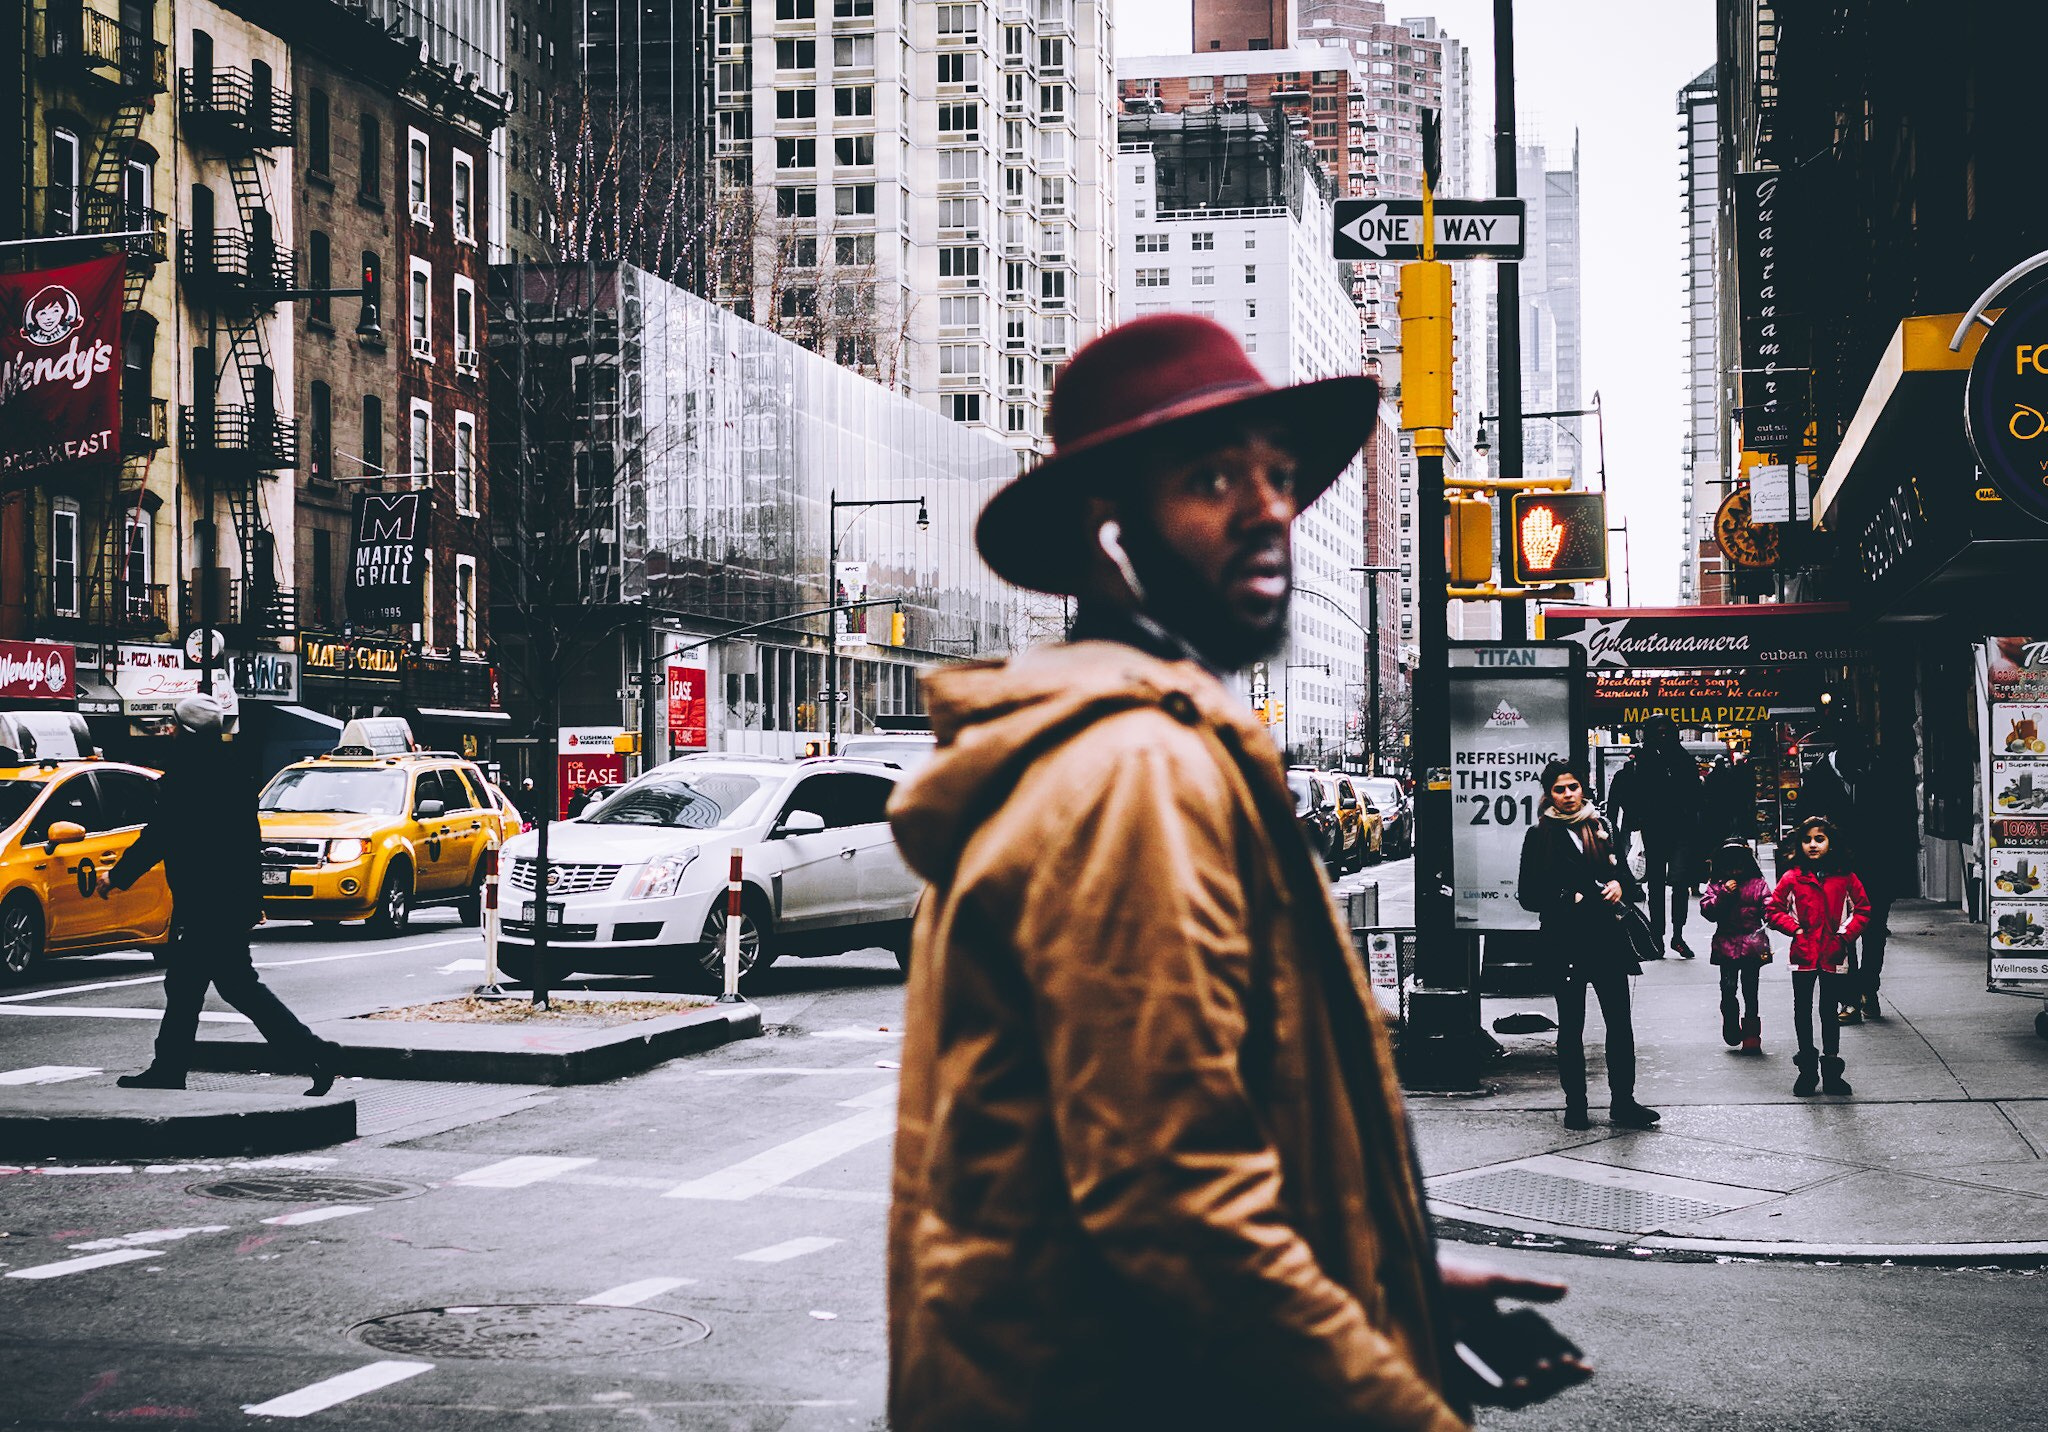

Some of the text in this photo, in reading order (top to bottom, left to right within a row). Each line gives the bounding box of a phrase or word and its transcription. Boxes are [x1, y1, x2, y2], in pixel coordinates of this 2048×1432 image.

[1358, 218, 1497, 242] ONE WAY
[1754, 177, 1781, 414] Guantanamera
[0, 335, 113, 405] Wendy's
[3, 429, 112, 474] BREAKFAST
[360, 494, 418, 542] M
[356, 544, 413, 566] MATTS
[355, 563, 411, 587] GRILL
[380, 606, 401, 618] 1995
[1589, 627, 1752, 661] Guantanamera
[131, 652, 152, 668] PIZZA
[157, 654, 180, 669] PASTA
[306, 642, 355, 670] MAT
[356, 646, 398, 672] GRILL
[1474, 649, 1536, 666] TITAN
[1760, 649, 1863, 661] cuban cuisin
[0, 650, 45, 691] Wendy's
[670, 680, 692, 701] LEASE
[1253, 661, 1266, 710] PARK
[1596, 677, 1653, 687] Breakfast
[1994, 683, 2021, 691] Fresh
[1593, 688, 1781, 698] Sandwich Pasta Cakes We Cater
[130, 702, 158, 712] GOURMET
[1490, 708, 1522, 721] Coors
[1717, 706, 1769, 722] PIZZA
[567, 761, 584, 769] FOR
[1456, 751, 1558, 765] REFRESHING
[567, 768, 618, 784] LEASE
[1456, 770, 1541, 790] THIS SPA
[1456, 794, 1533, 826] IN 201
[2003, 820, 2037, 837] 100%
[1993, 963, 2038, 974] Wellness
